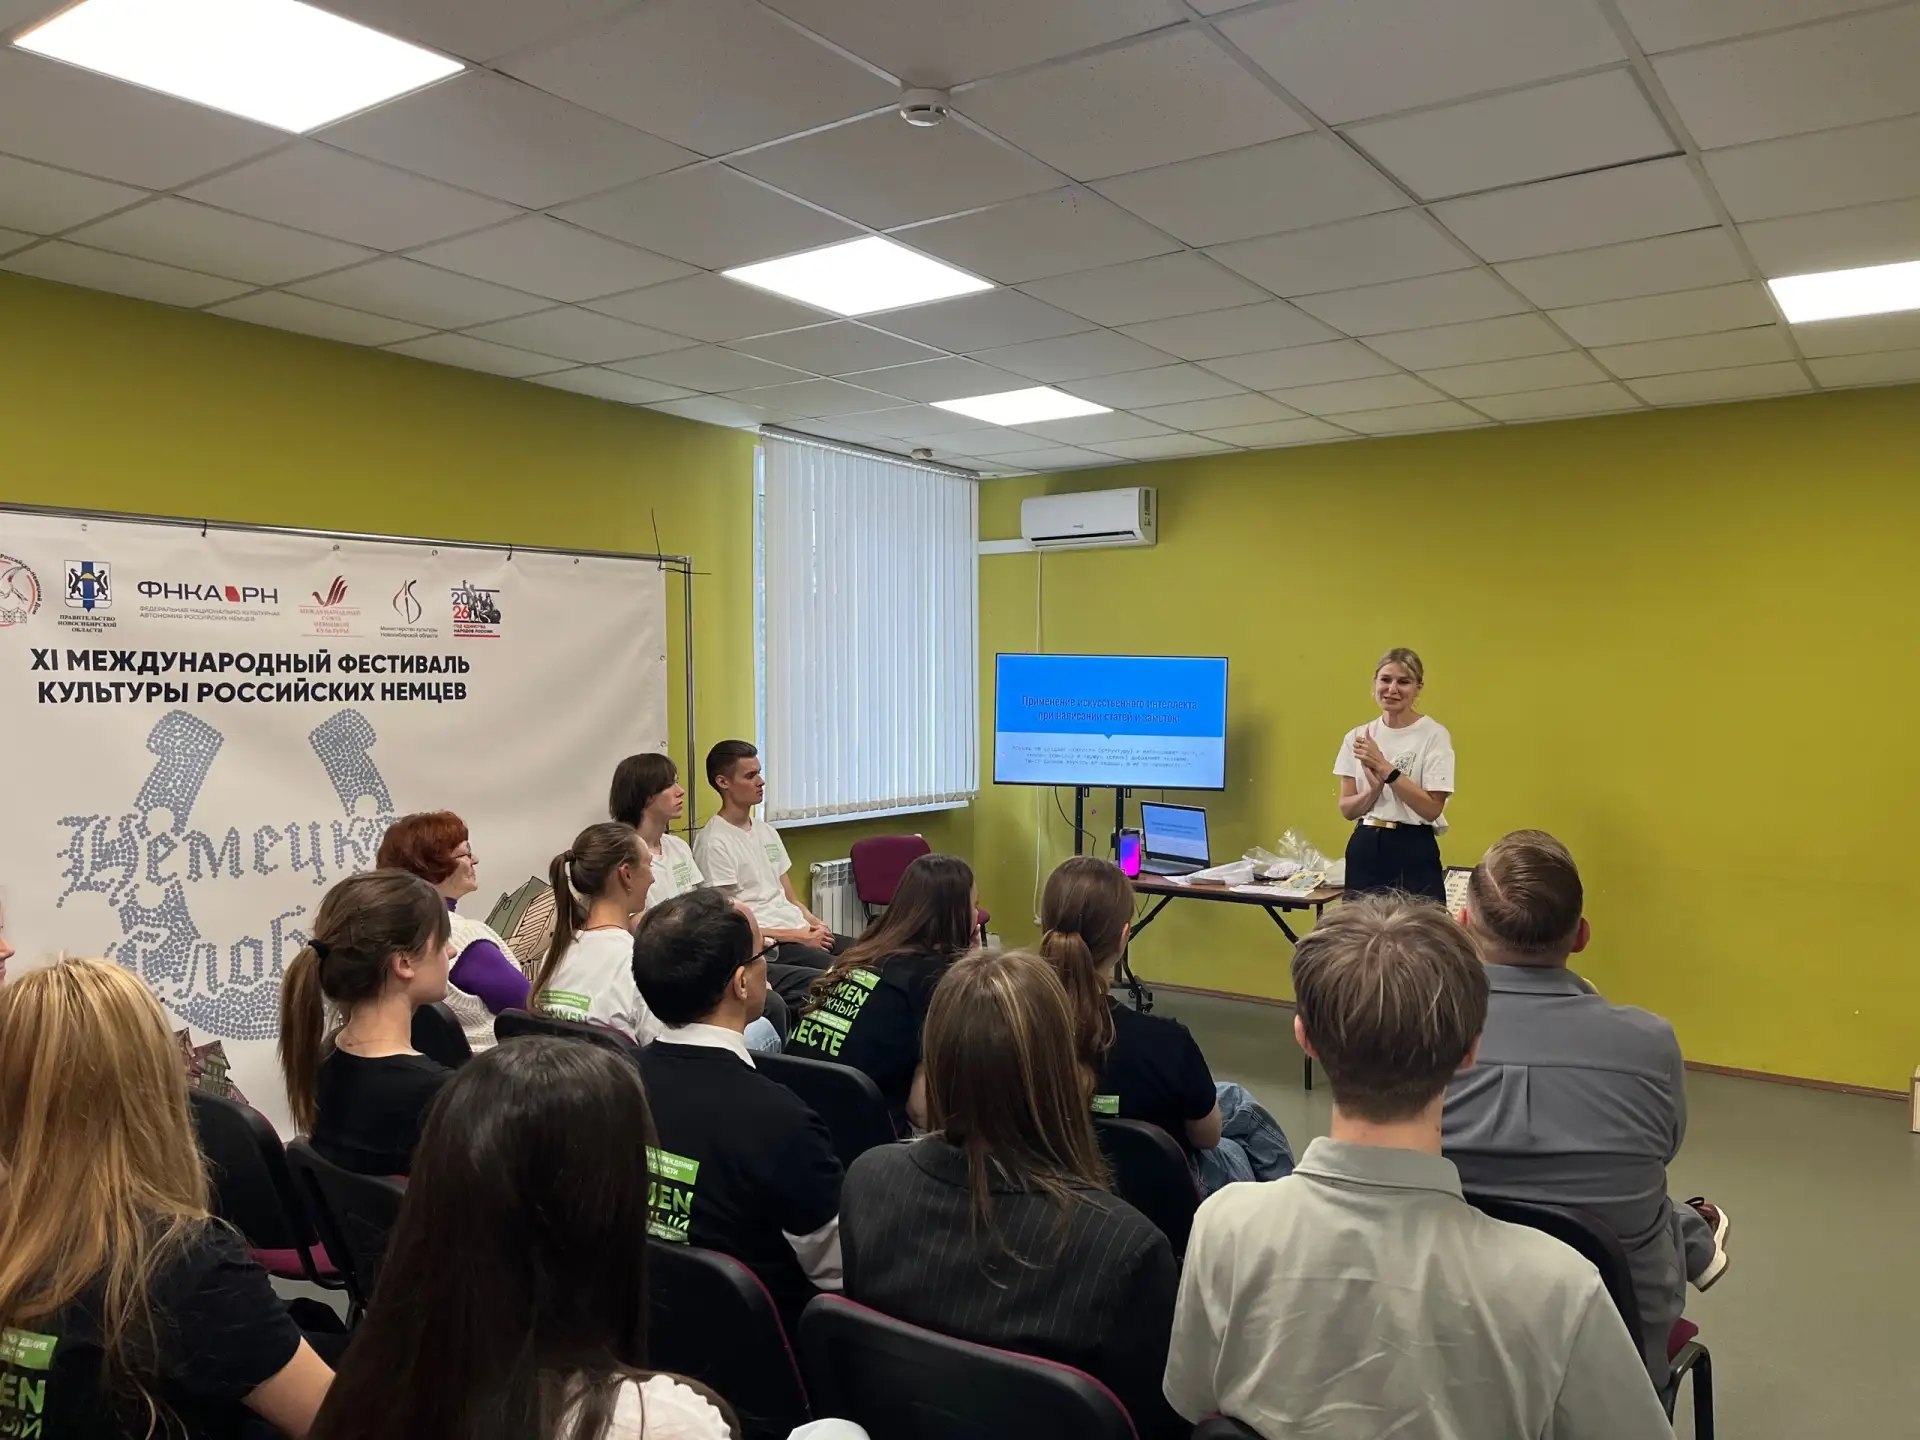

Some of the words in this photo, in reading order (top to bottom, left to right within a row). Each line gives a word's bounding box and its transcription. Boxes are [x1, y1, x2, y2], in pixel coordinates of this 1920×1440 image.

[137, 581, 223, 602] ФНКА
[242, 586, 279, 604] РН
[453, 605, 470, 619] 26
[30, 649, 59, 671] XI
[66, 648, 331, 676] МЕЖДУНАРОДНЫЙ
[337, 654, 470, 674] ФЕСТИВАЛЬ
[38, 682, 188, 703] КУЛЬТУРЫ
[197, 677, 375, 702] РОССИЙСКИХ
[381, 682, 467, 703] НЕМЦЕВ
[1021, 695, 1075, 707] Применение
[1077, 697, 1145, 709] искусственного
[1146, 699, 1197, 710] интеллекта
[0, 1371, 47, 1414] EN
